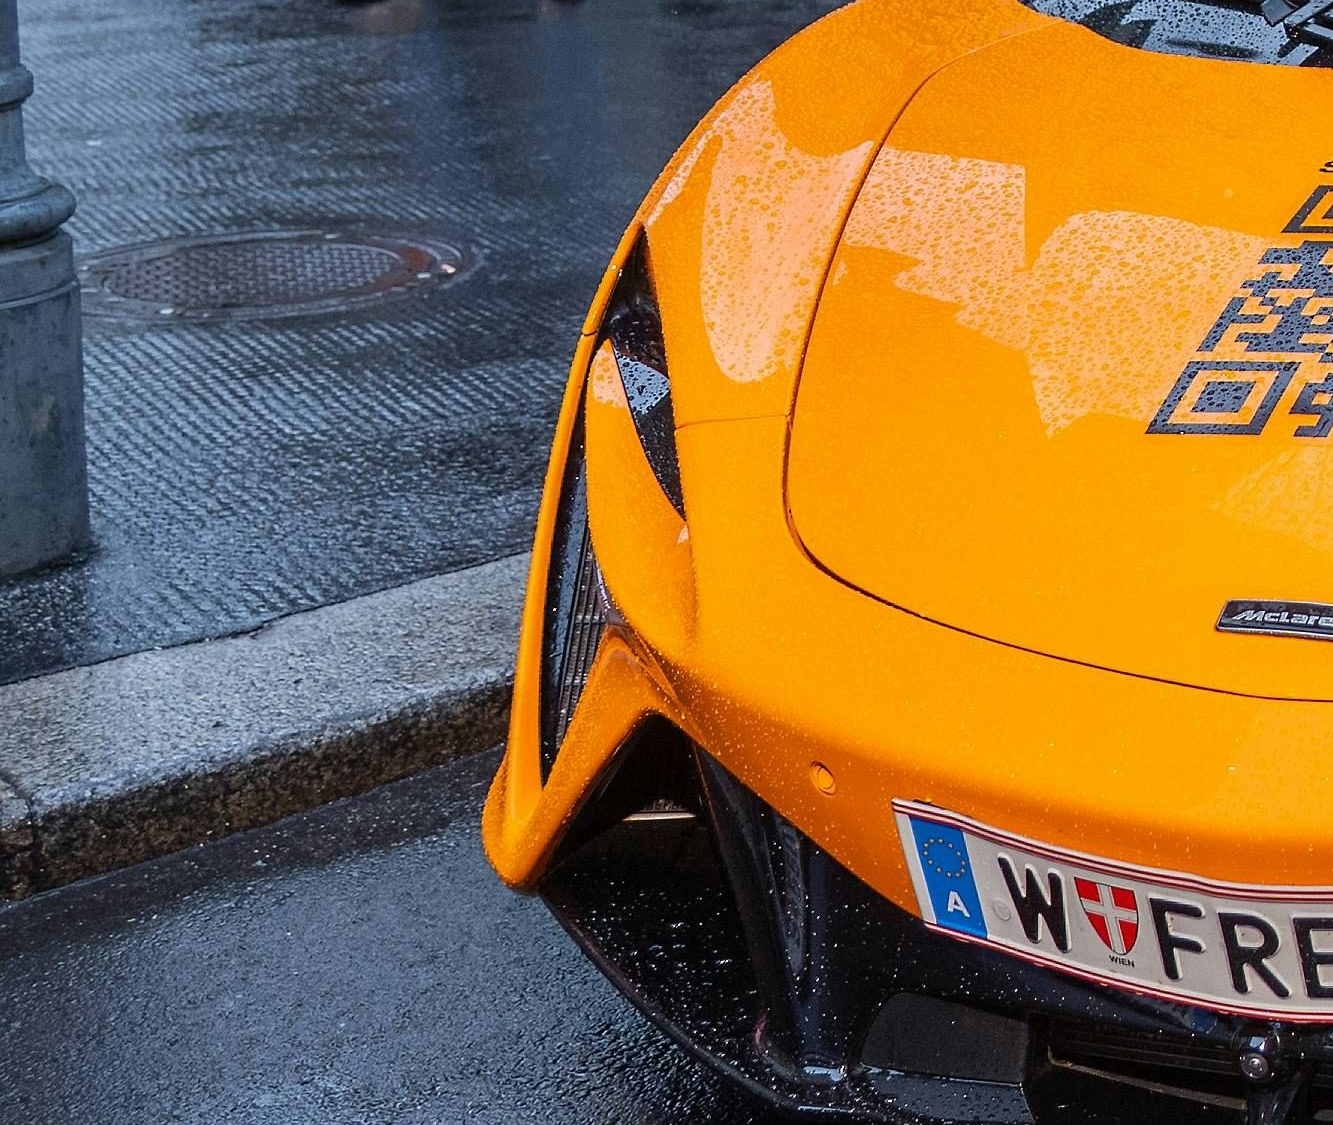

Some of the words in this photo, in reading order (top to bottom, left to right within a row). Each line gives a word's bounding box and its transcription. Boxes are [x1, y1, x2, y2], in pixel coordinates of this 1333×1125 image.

[946, 889, 972, 919] A
[996, 855, 1070, 953] W
[1109, 954, 1136, 968] WIEN
